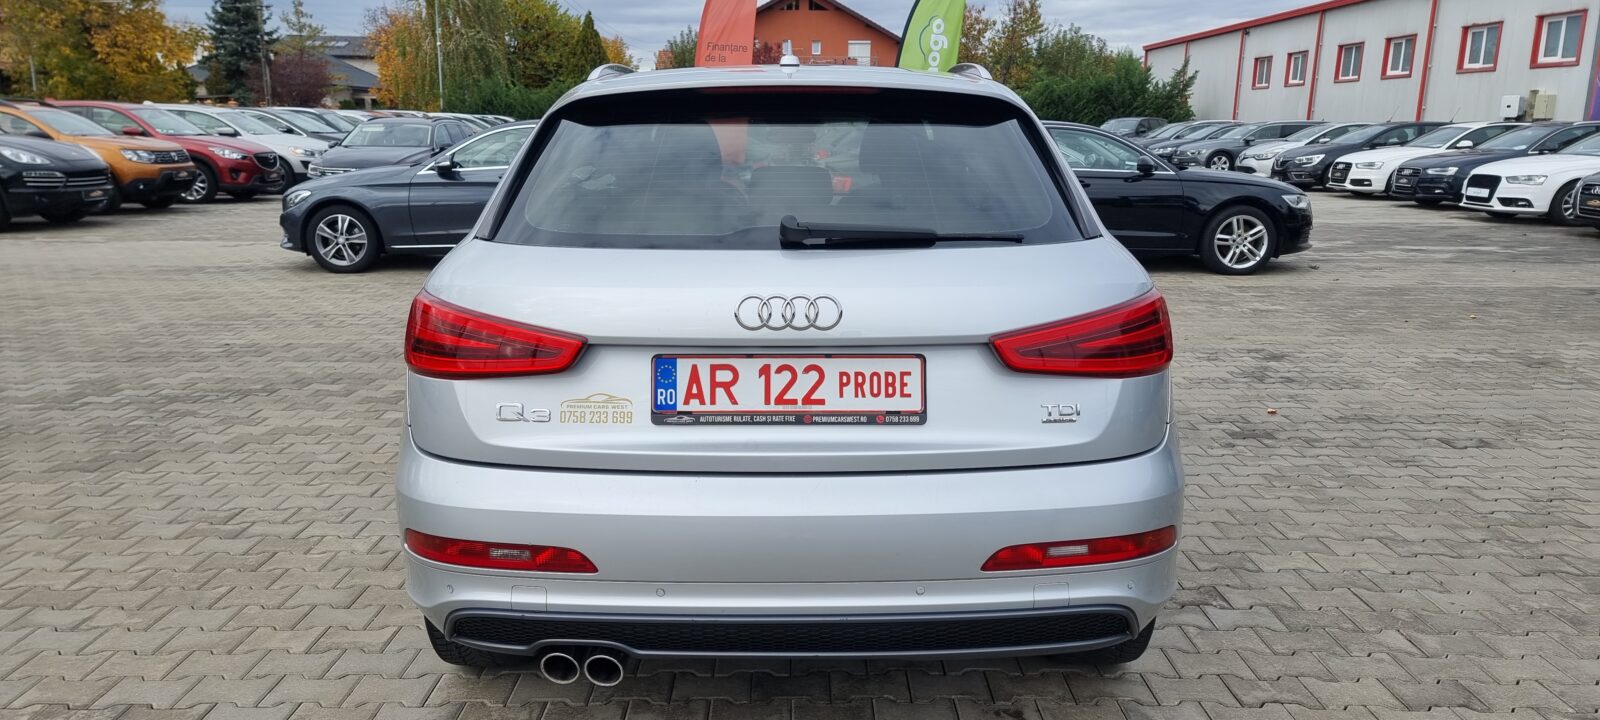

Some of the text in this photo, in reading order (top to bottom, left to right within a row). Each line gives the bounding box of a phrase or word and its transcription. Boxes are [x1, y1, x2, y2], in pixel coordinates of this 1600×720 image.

[704, 53, 727, 63] de la
[682, 363, 912, 406] AR 122 PROBE
[657, 388, 676, 405] RO
[496, 402, 551, 422] Q3
[559, 410, 633, 424] 0758 233 699
[1040, 403, 1081, 417] TDI
[700, 415, 733, 423] AUTOTURISME
